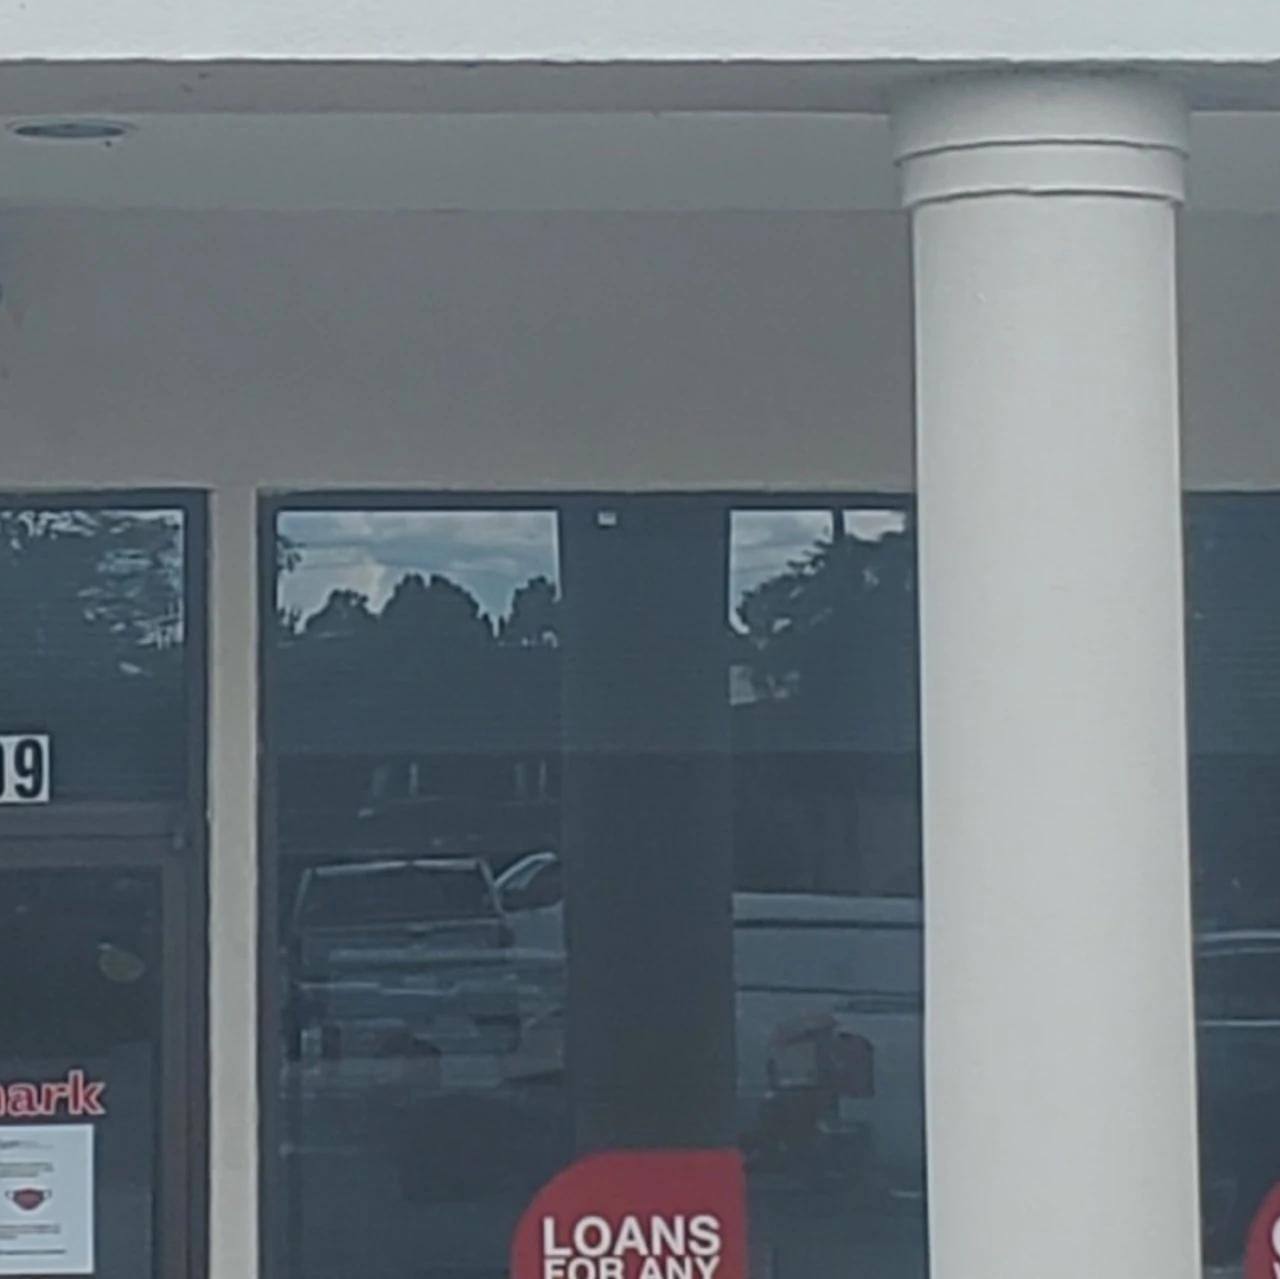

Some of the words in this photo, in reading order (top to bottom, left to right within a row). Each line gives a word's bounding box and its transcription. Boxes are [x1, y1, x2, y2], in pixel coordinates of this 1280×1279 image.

[542, 1215, 721, 1257] LOANS
[543, 1257, 625, 1279] FOR
[638, 1256, 720, 1279] ANY
